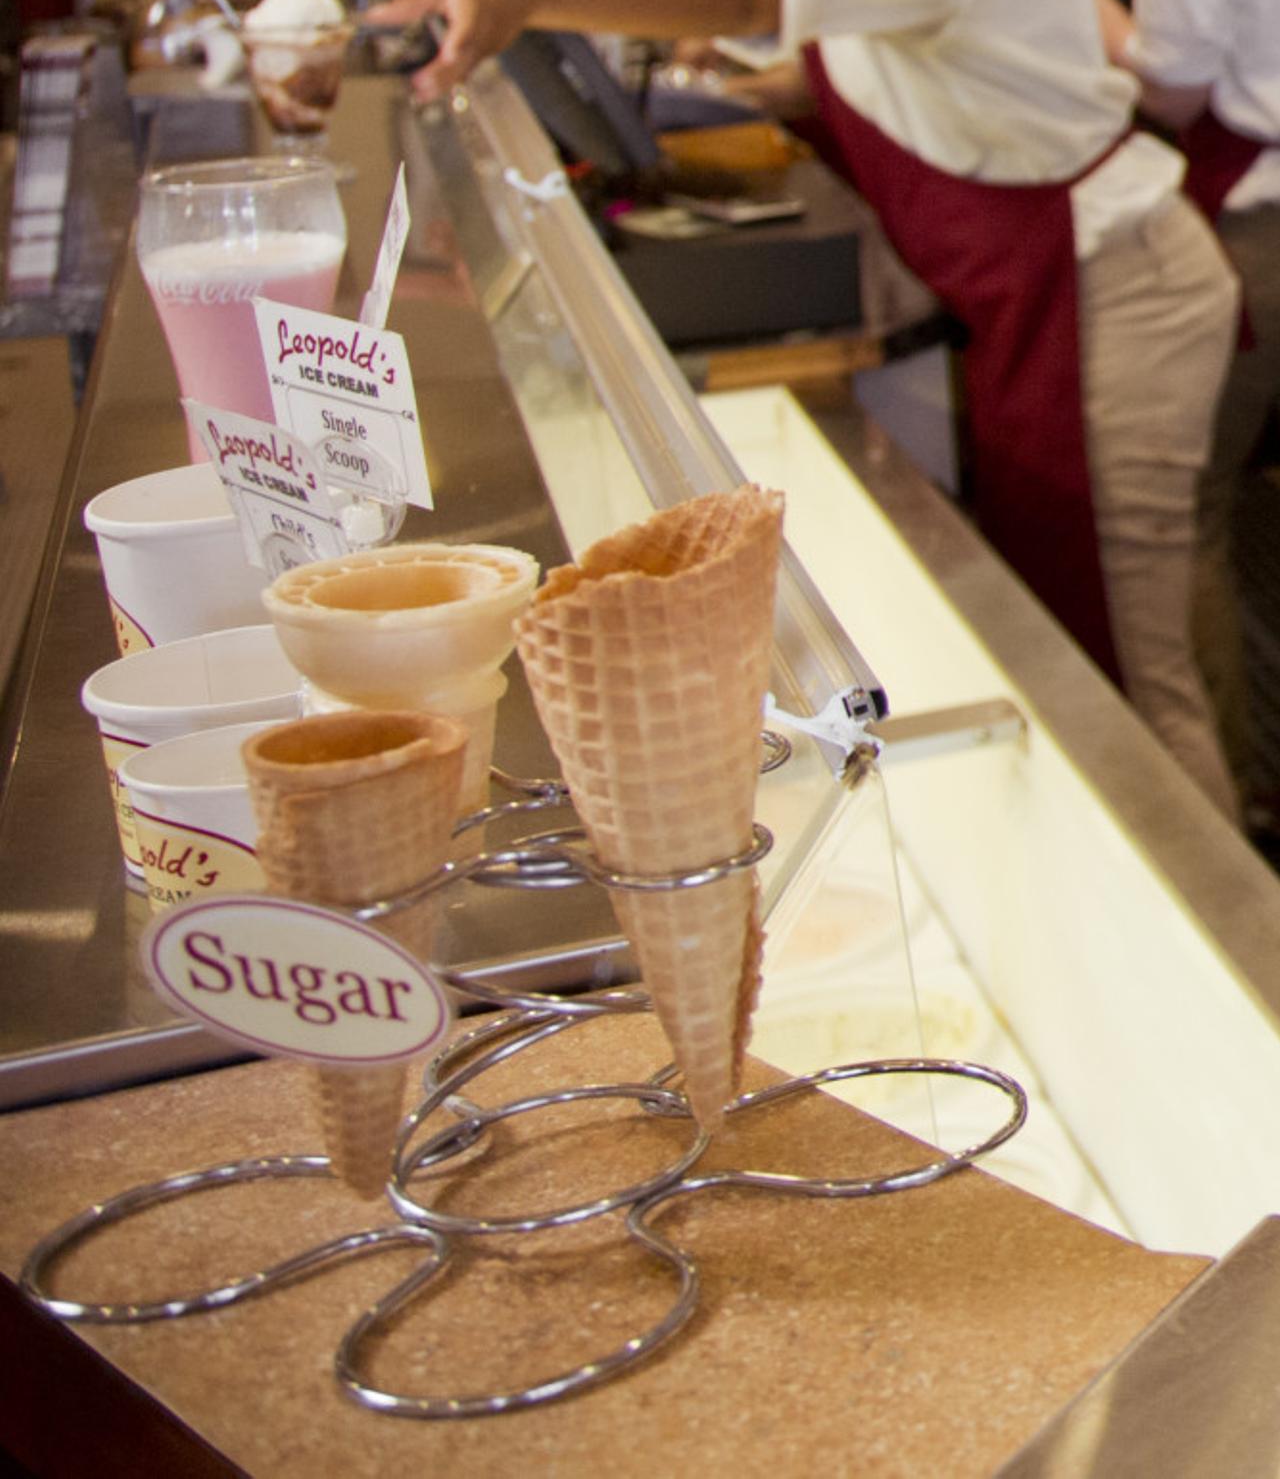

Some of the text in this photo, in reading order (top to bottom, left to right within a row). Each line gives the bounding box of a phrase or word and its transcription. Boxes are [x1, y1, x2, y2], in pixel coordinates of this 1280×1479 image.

[277, 319, 395, 384] Leopold's
[299, 365, 379, 398] ICE CREAM
[321, 409, 367, 440] Single
[207, 419, 317, 490] Leopold's
[324, 442, 369, 477] Scoop
[239, 466, 309, 502] ICE CREAM
[141, 838, 220, 887] old's
[183, 931, 411, 1025] Sugar
